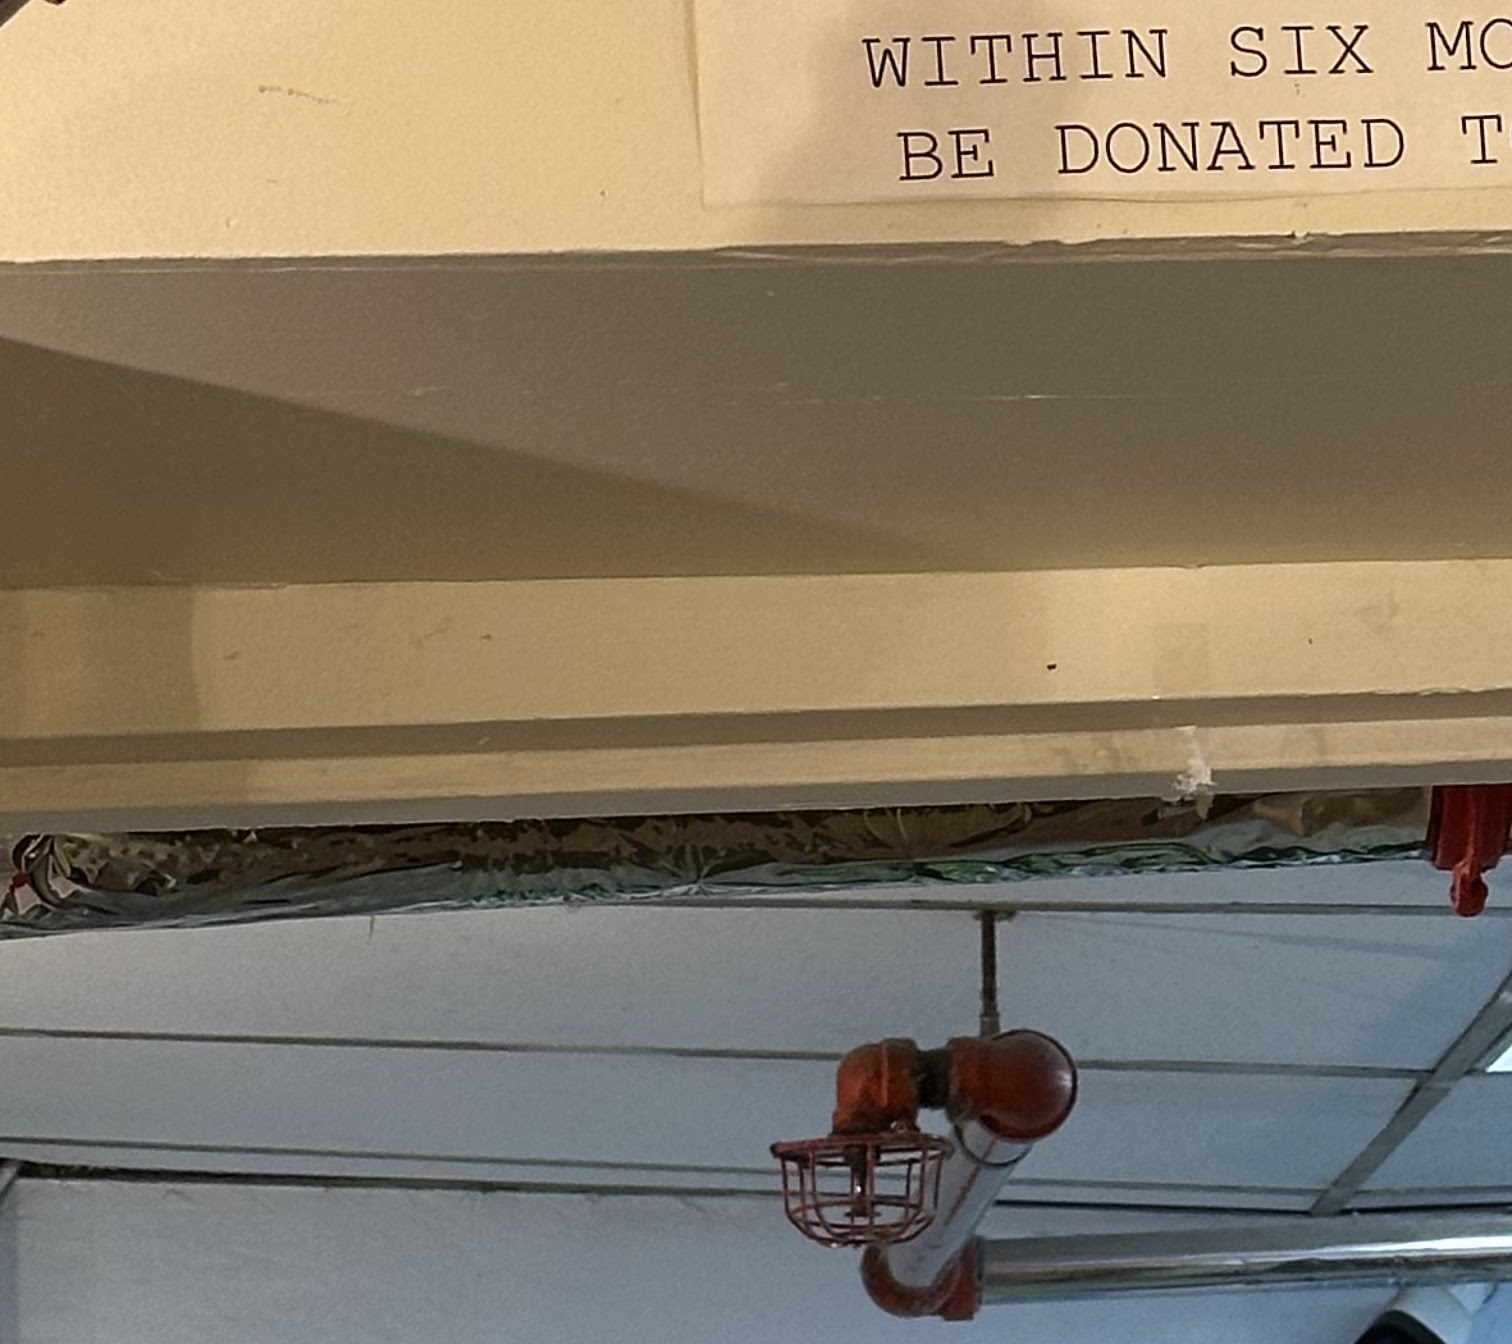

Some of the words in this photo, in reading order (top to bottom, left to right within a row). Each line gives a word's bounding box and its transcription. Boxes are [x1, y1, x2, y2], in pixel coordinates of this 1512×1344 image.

[863, 29, 1168, 88] WITHIN
[1230, 23, 1374, 77] SIX
[895, 126, 994, 184] BE
[1053, 117, 1405, 175] DONATED
